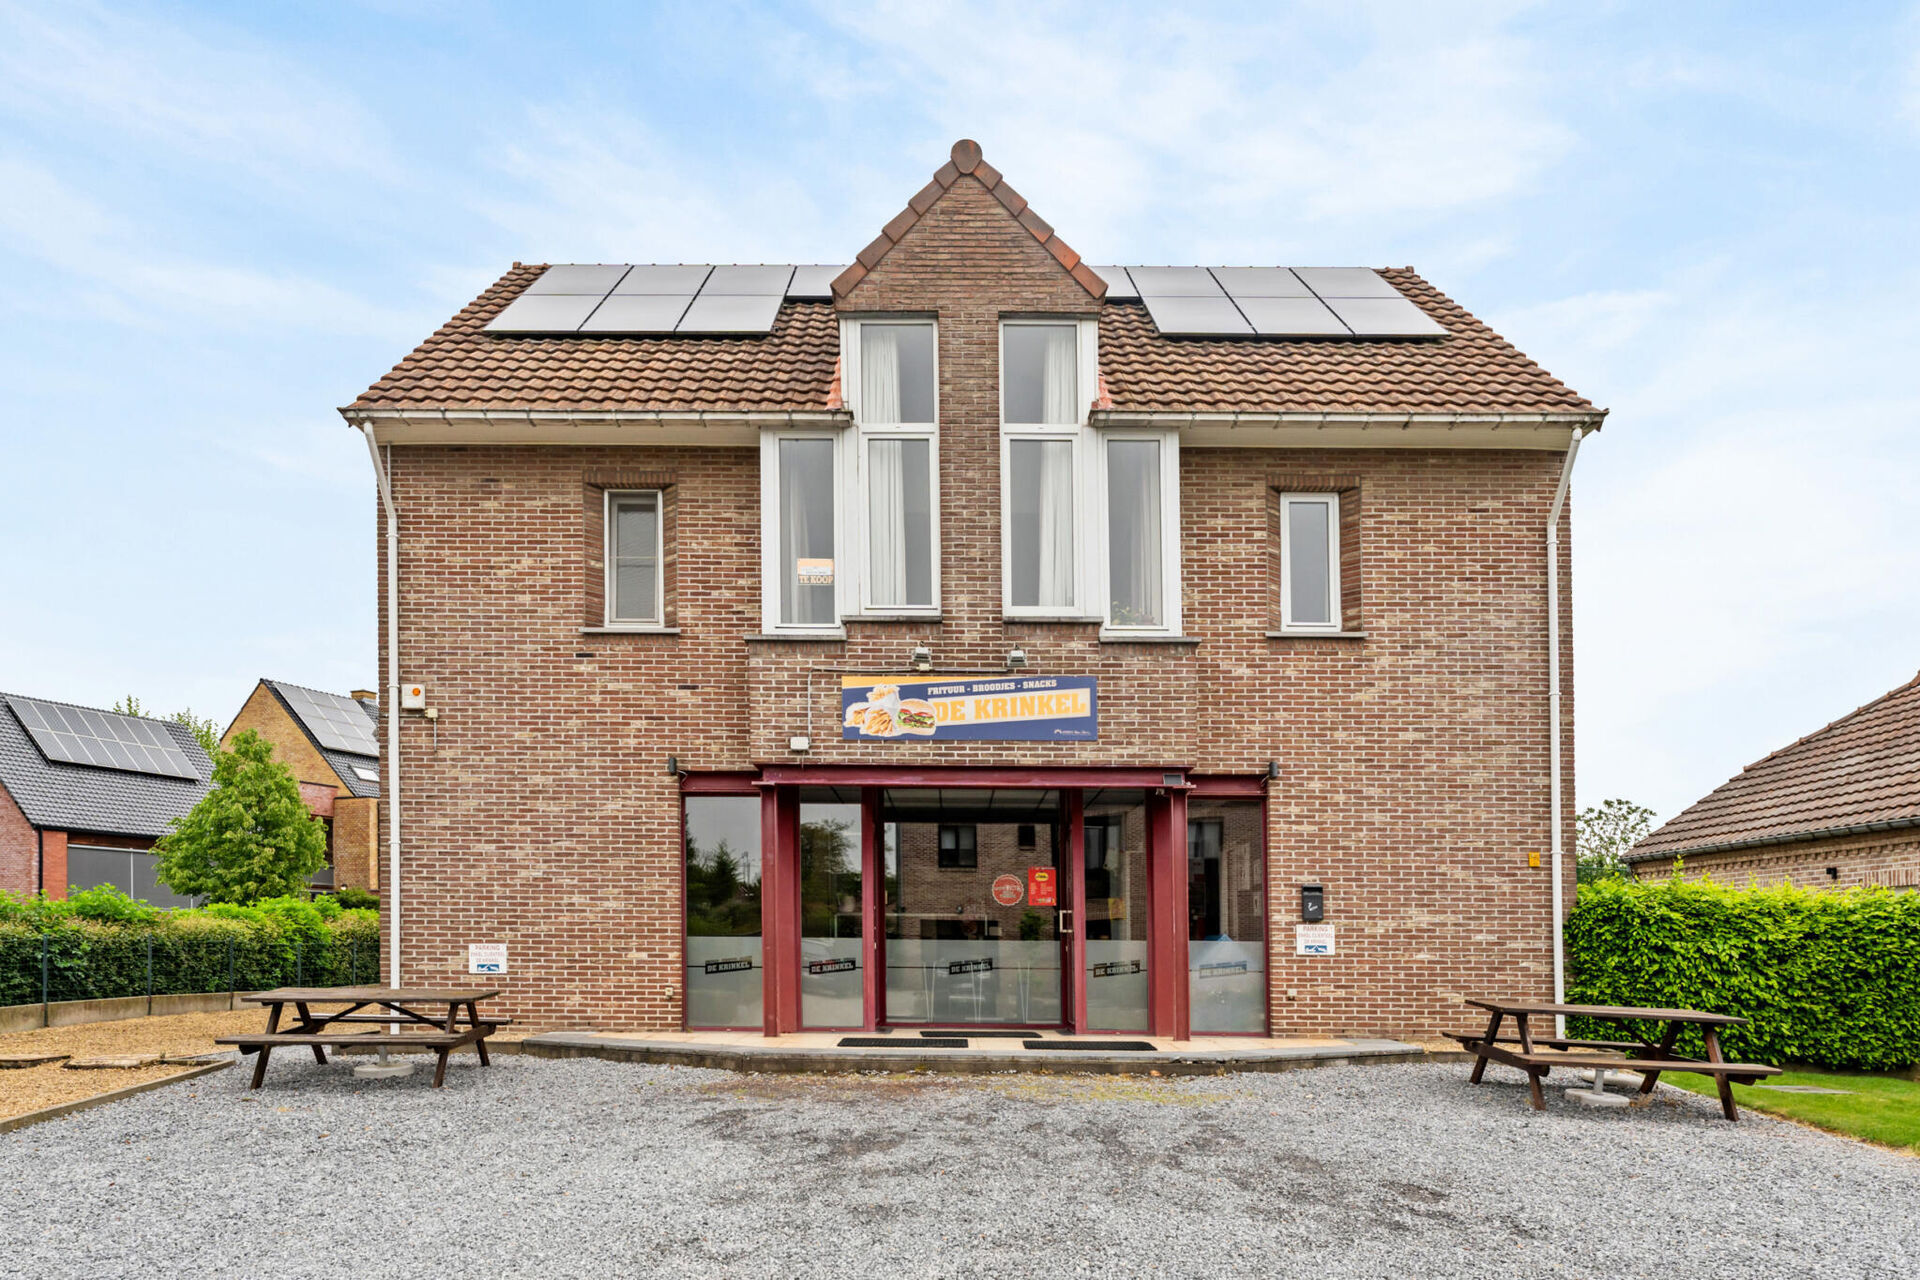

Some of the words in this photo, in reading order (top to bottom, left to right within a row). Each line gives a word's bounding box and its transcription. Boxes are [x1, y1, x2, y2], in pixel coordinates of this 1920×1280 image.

[927, 685, 965, 695] FRITUUR
[972, 682, 1016, 692] BROODJES
[1022, 679, 1057, 689] SNACKS
[933, 700, 966, 722] DE
[974, 693, 1088, 720] KRINKEL
[707, 965, 717, 973] DE
[718, 962, 750, 971] KRINKEL
[811, 965, 821, 973] DE
[822, 962, 854, 972] KRINKEL
